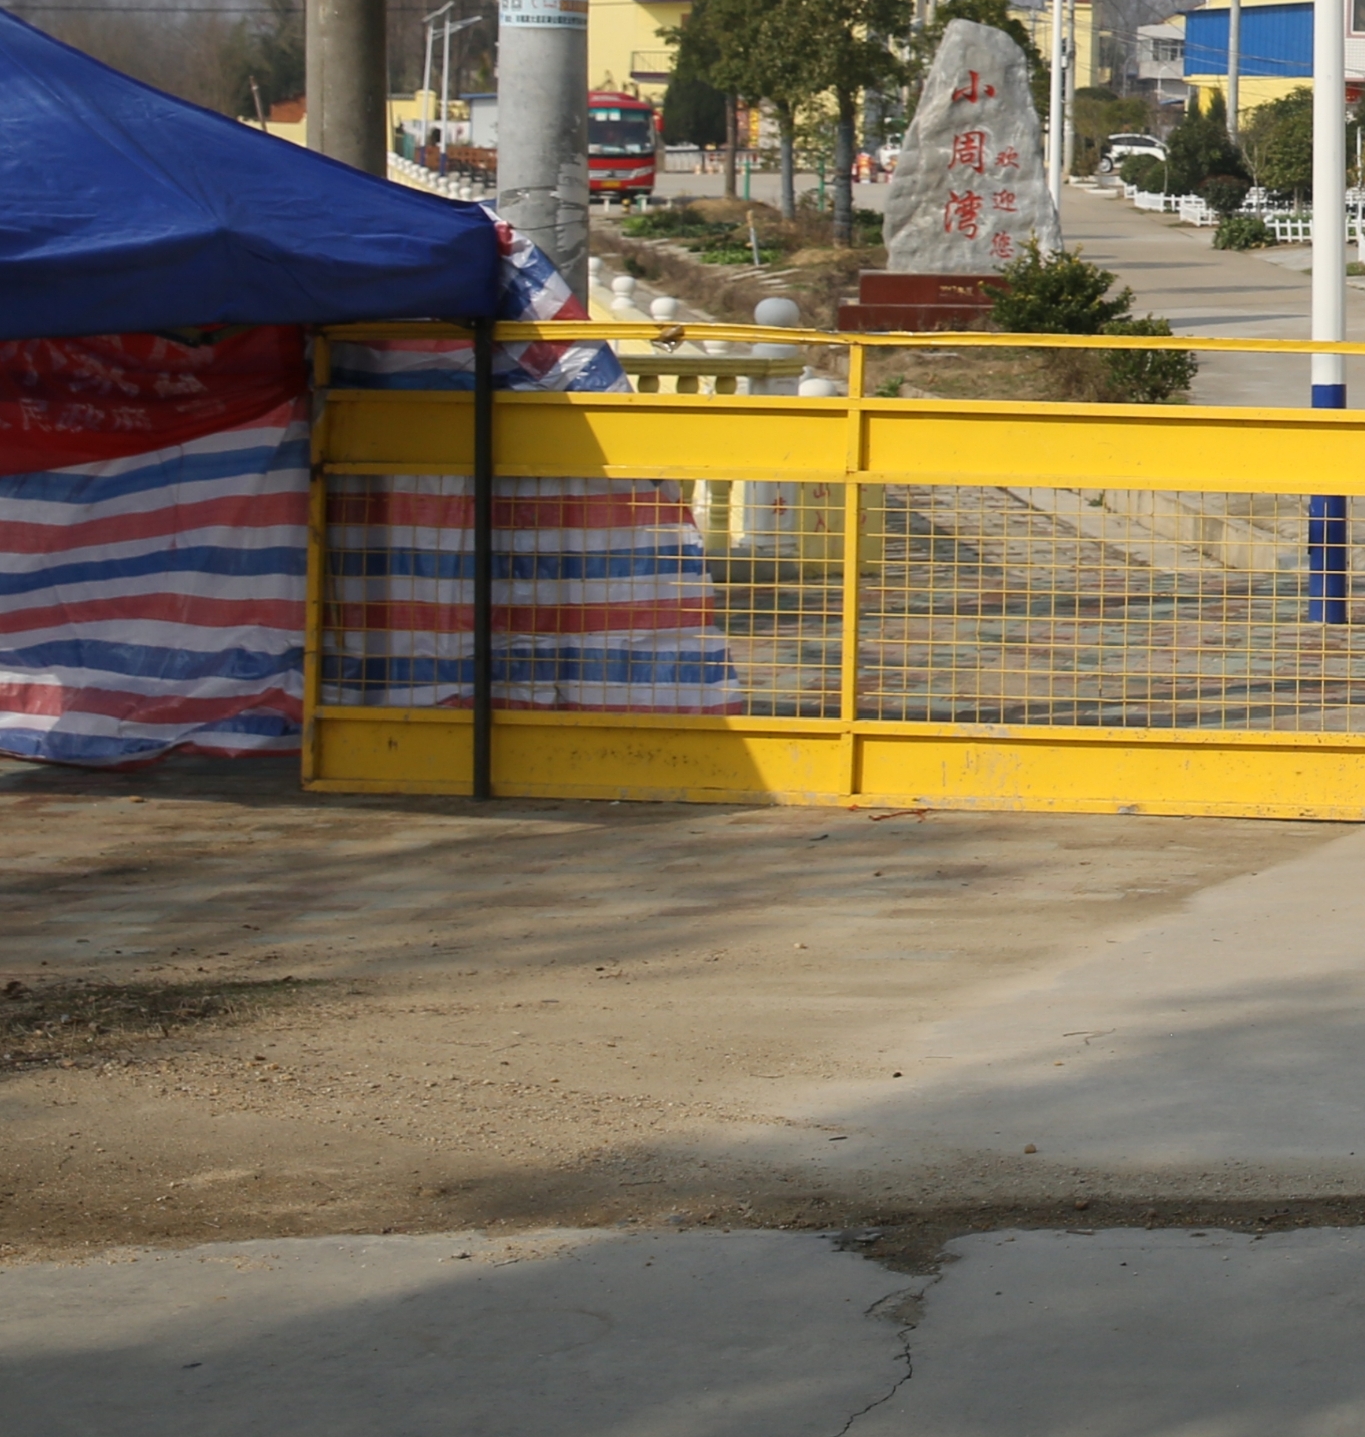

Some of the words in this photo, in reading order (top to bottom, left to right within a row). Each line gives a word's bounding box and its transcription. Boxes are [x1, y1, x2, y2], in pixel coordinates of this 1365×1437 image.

[944, 69, 996, 241] 小周湾
[989, 146, 1020, 259] 欢迎您
